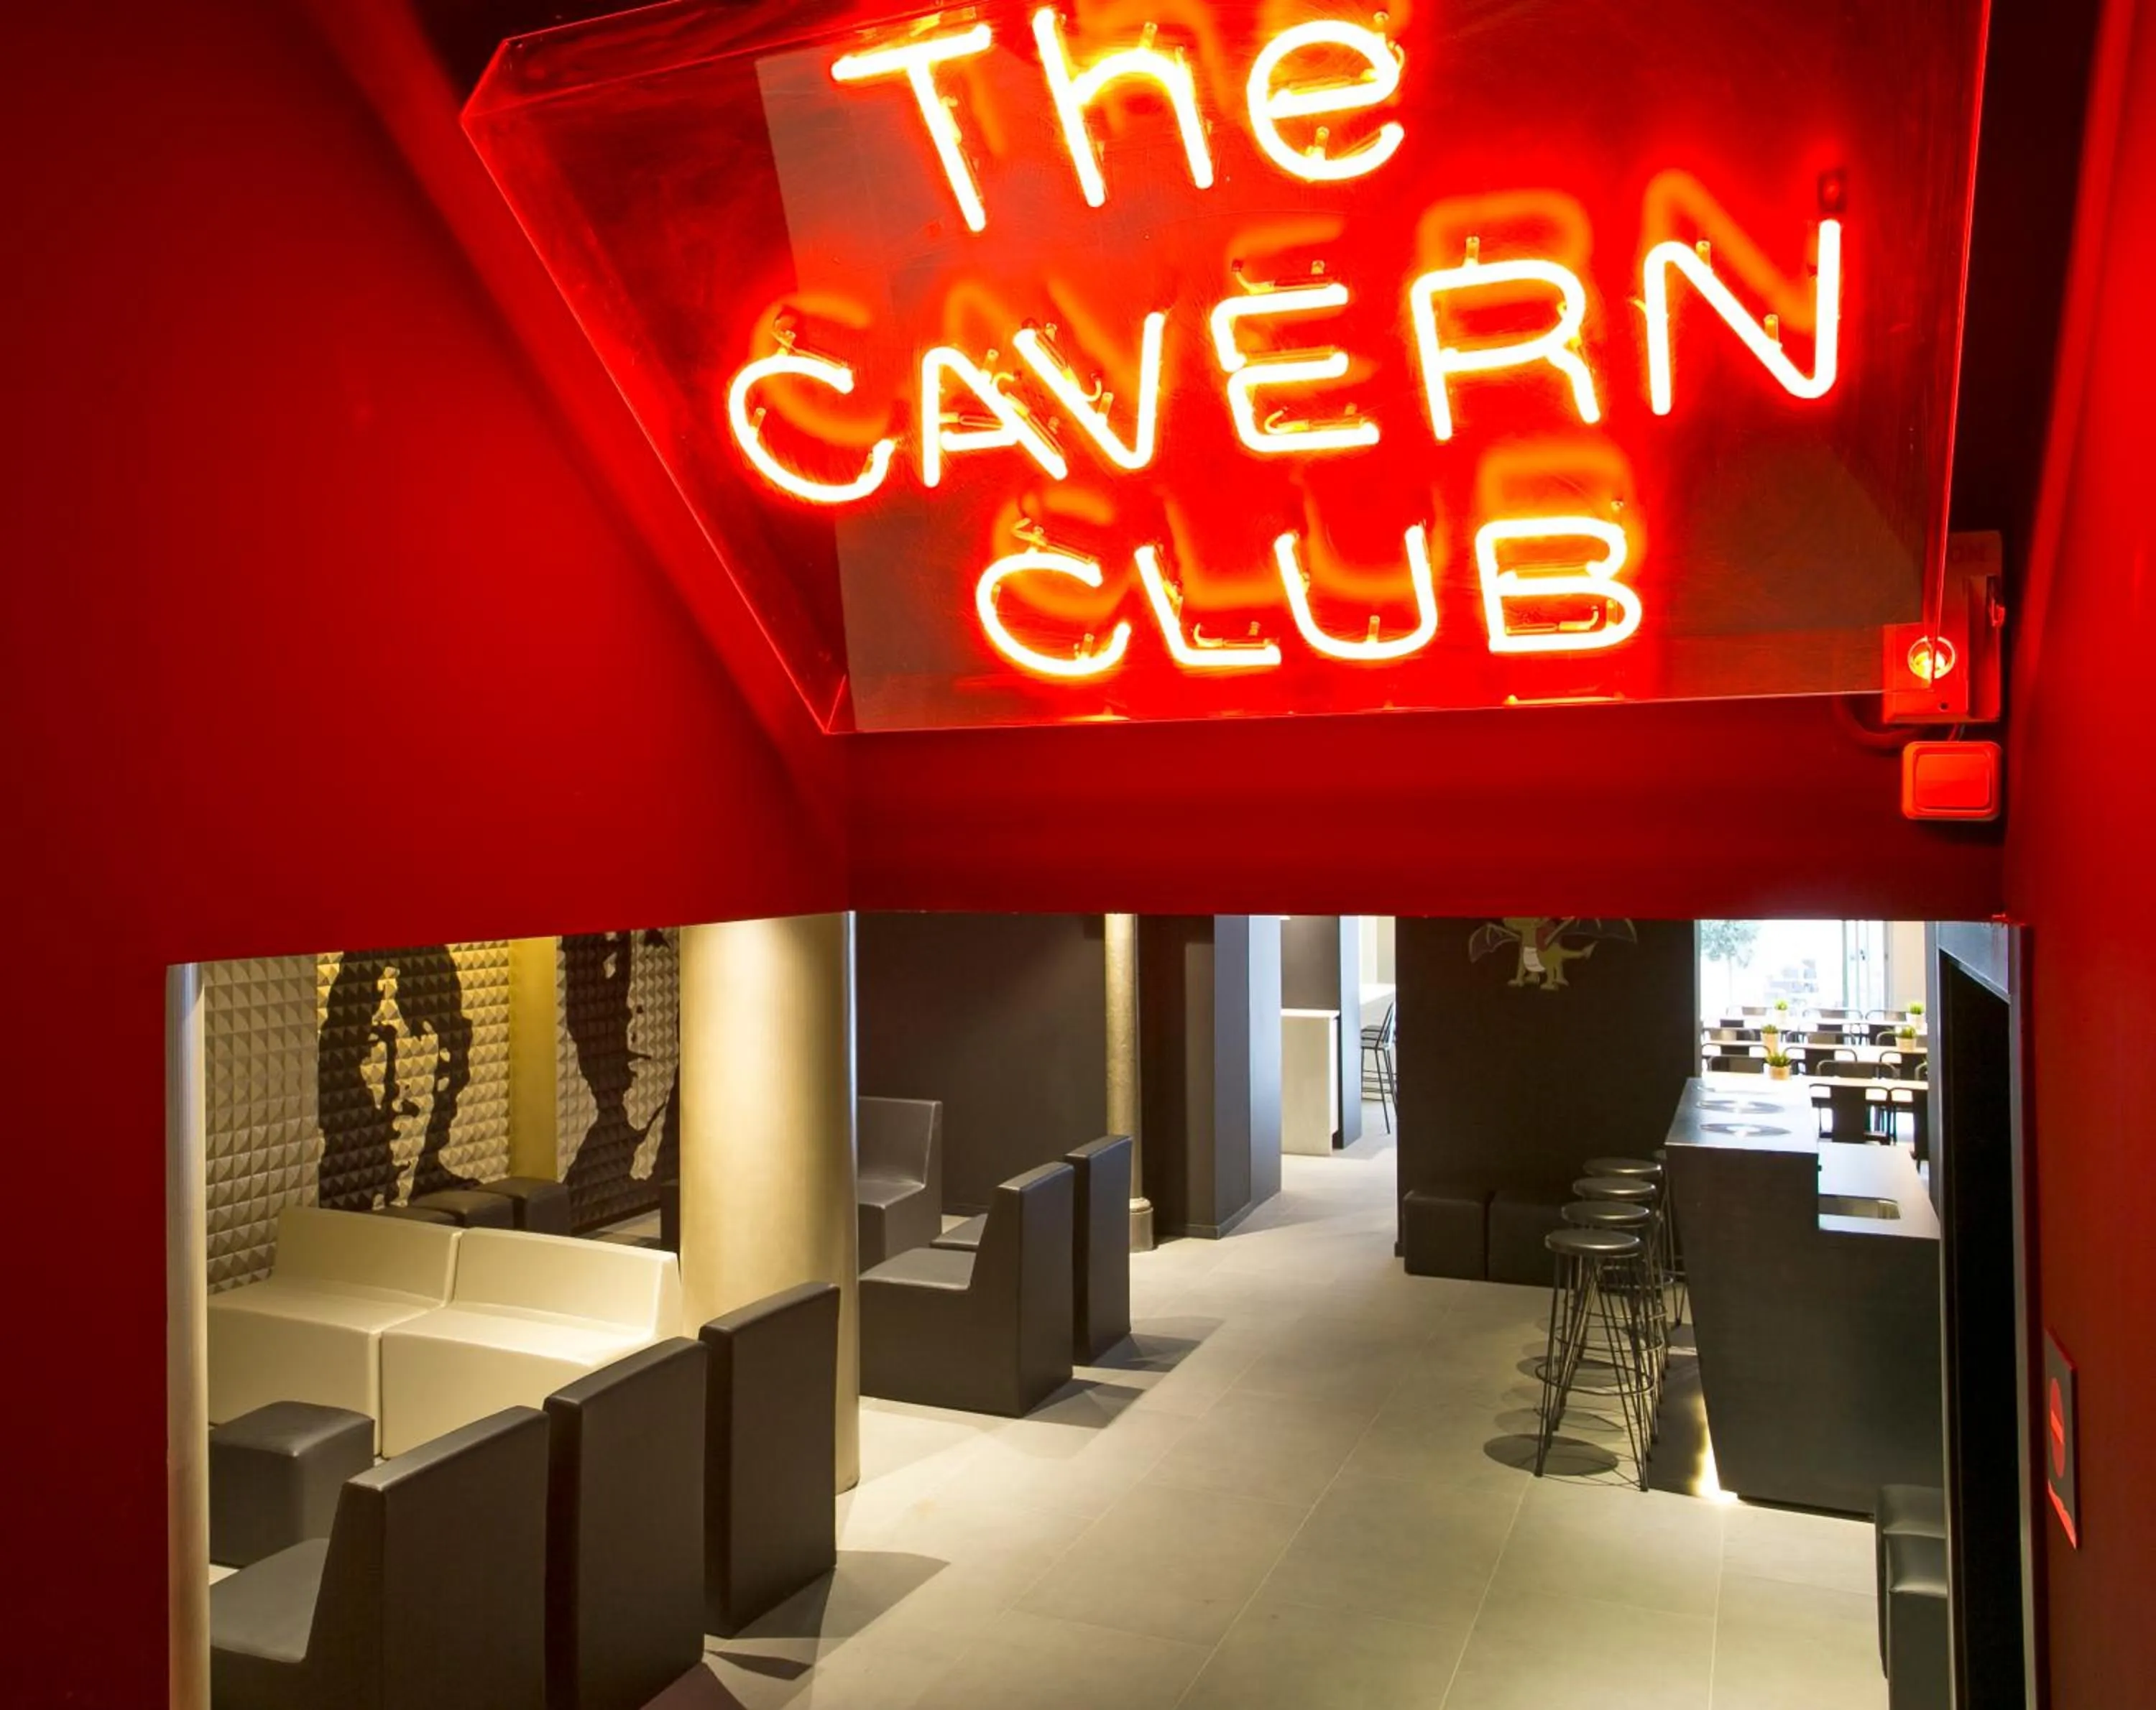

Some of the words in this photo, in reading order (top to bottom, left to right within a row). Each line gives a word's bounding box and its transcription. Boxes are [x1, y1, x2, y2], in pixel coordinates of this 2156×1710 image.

[831, 9, 1405, 232] The
[728, 219, 1842, 503] CAVERN
[975, 514, 1643, 678] CLUB
